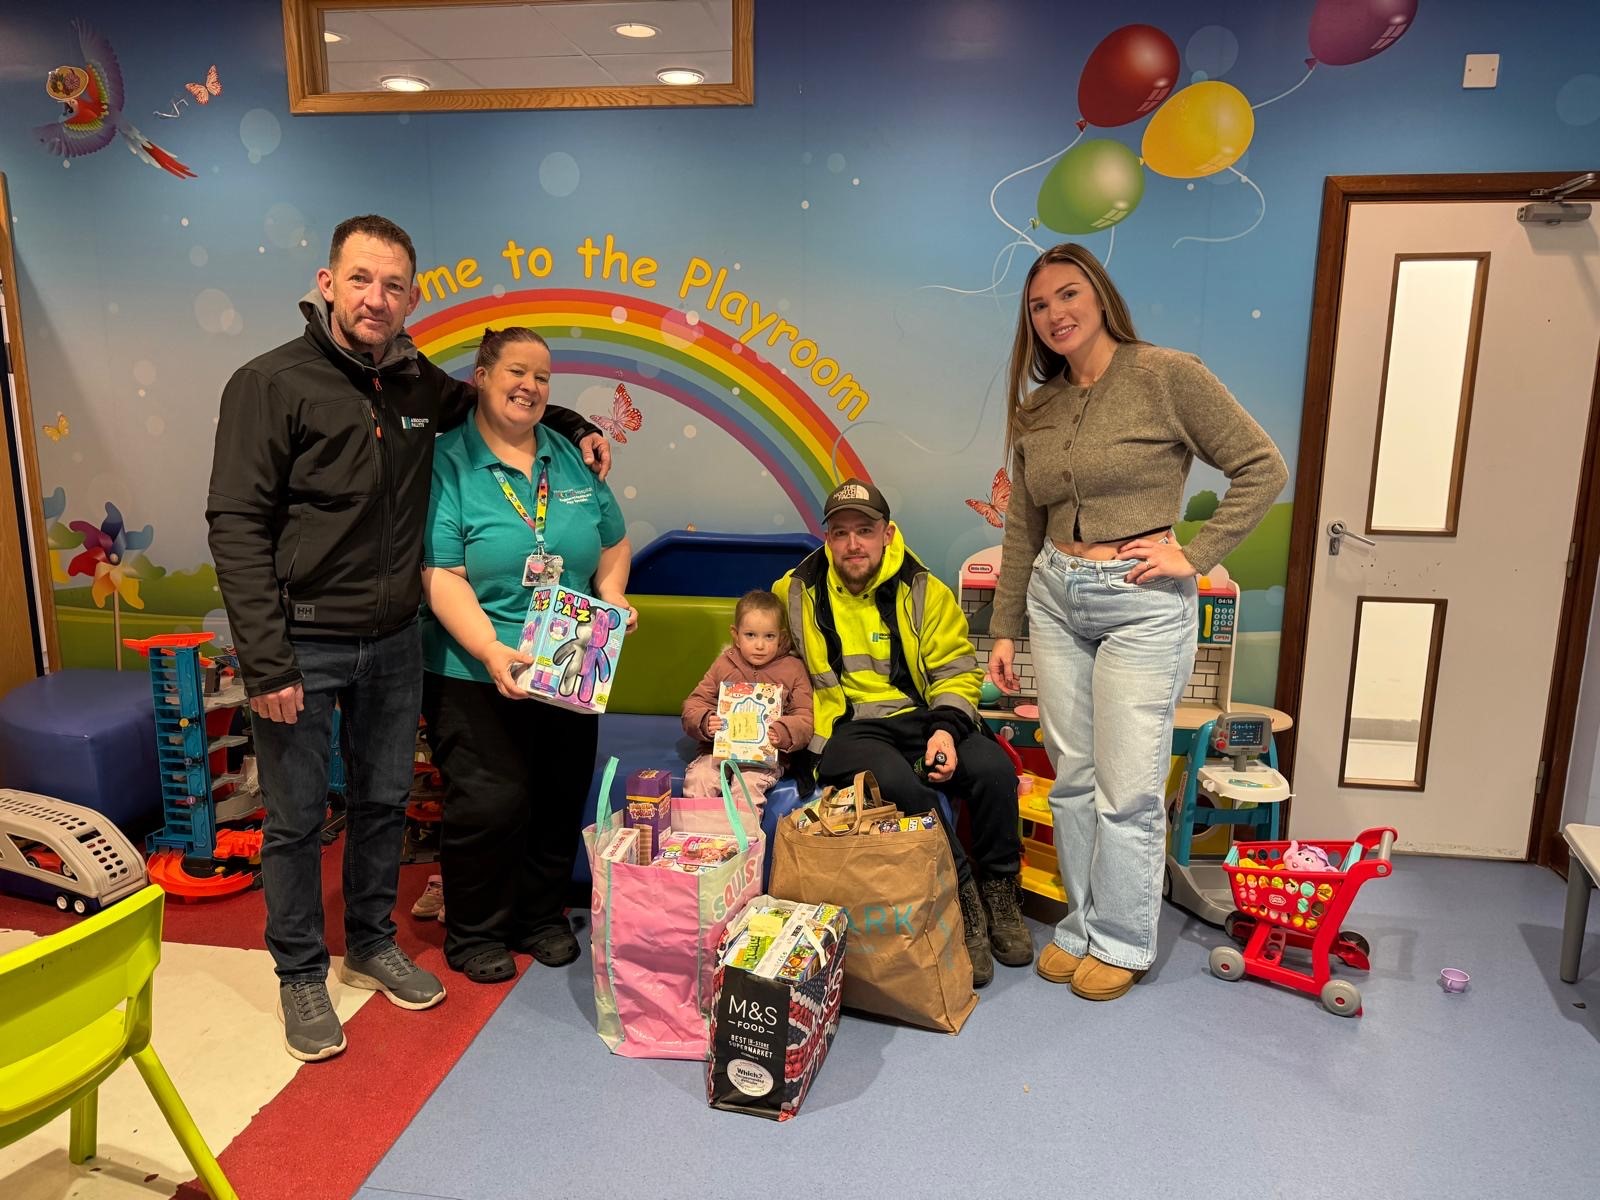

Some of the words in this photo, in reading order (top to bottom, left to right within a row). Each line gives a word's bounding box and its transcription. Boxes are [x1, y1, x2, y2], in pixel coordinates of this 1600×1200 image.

[501, 239, 554, 281] to
[576, 234, 659, 289] the
[678, 256, 870, 422] Playroom
[557, 590, 590, 610] POUR
[554, 600, 591, 623] PALZ
[728, 994, 778, 1026] M&S
[737, 1021, 765, 1034] FOOD
[731, 1034, 747, 1045] BEST
[728, 1040, 773, 1059] SUPERMARKET
[737, 1067, 763, 1079] Which?
